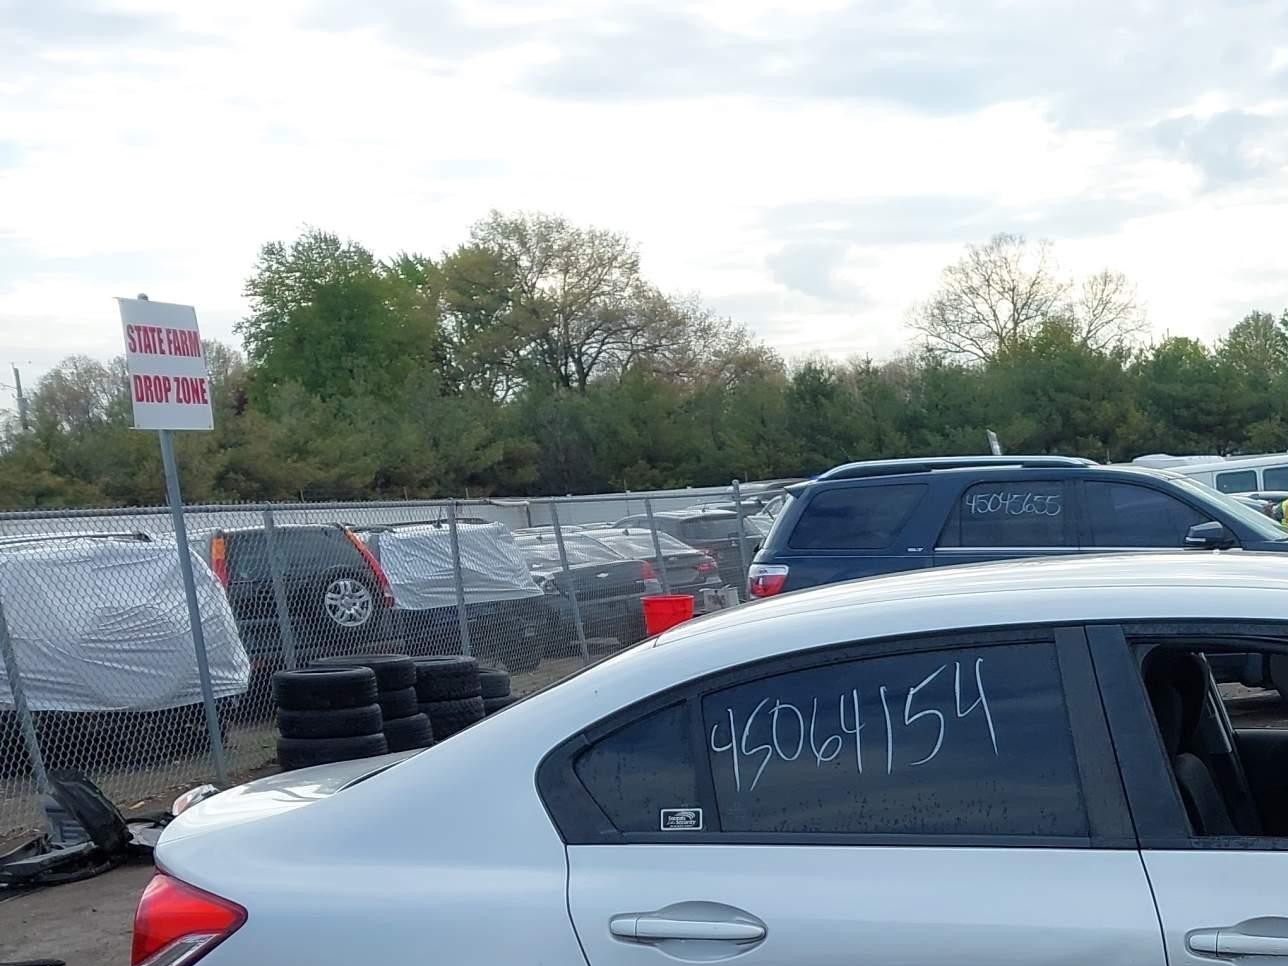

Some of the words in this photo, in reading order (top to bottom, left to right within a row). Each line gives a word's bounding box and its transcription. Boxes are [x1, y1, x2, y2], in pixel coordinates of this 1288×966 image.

[126, 324, 166, 355] STATE
[165, 328, 202, 358] FARM
[133, 374, 172, 404] DROP
[173, 376, 209, 405] ZONE
[965, 492, 1062, 516] 45045655
[710, 657, 999, 793] 45064154
